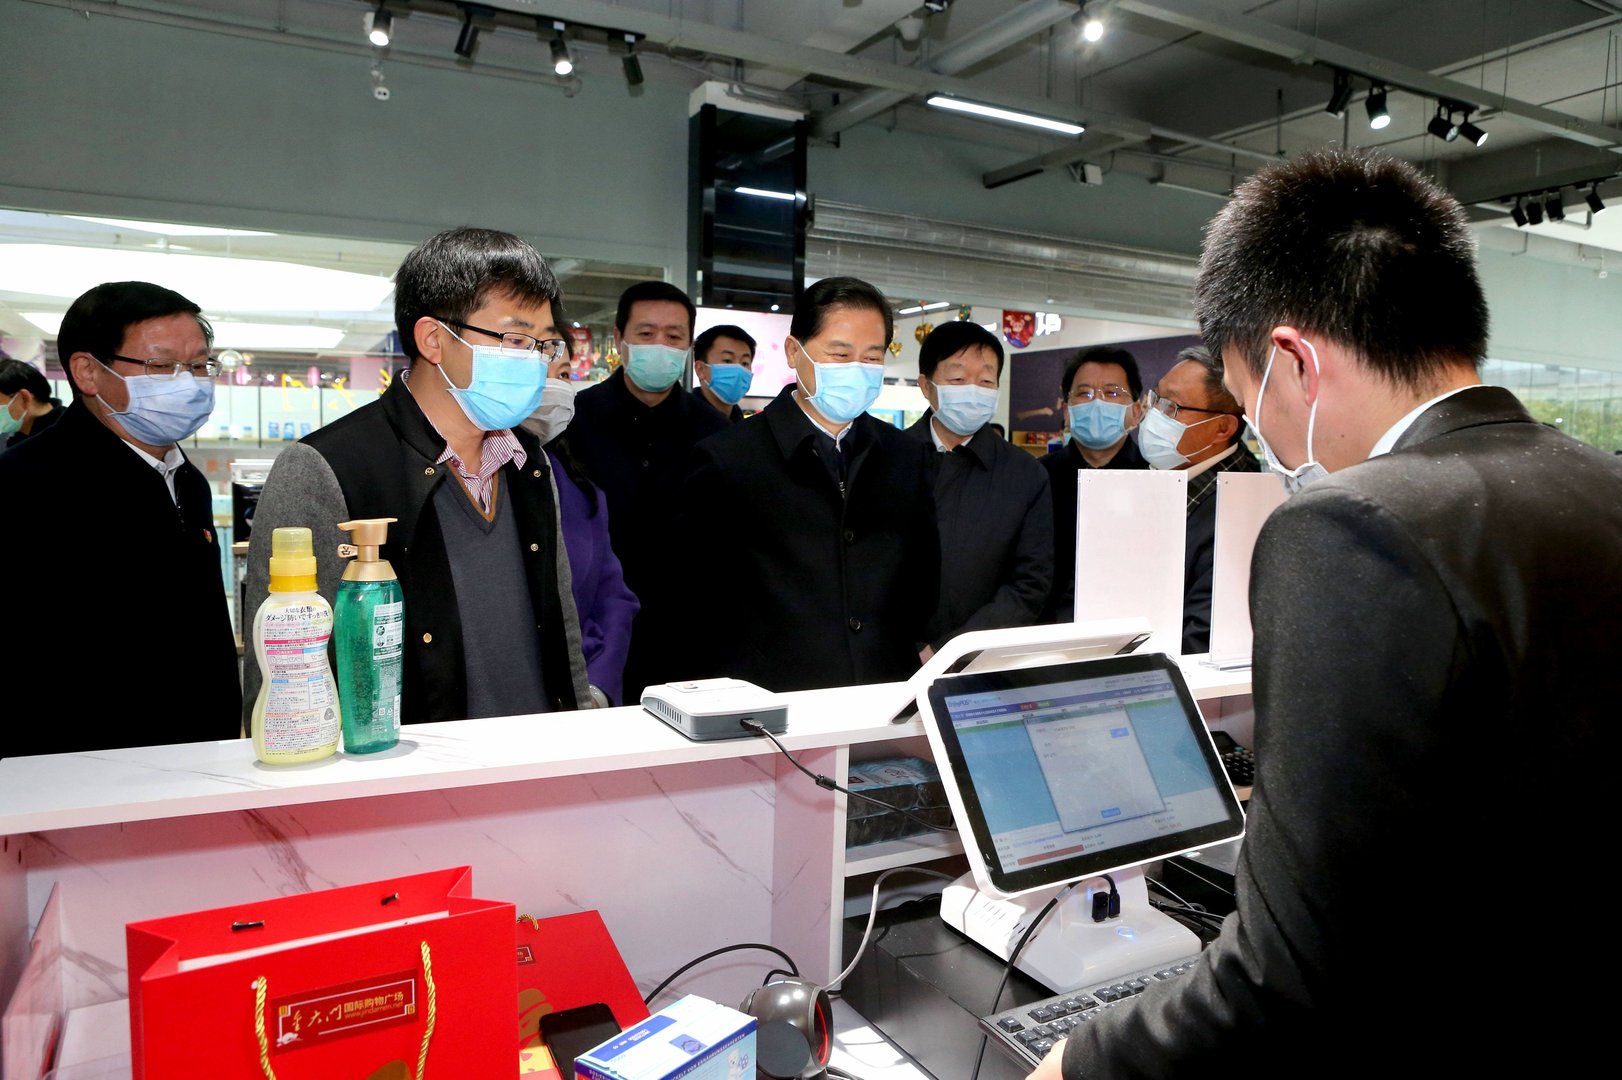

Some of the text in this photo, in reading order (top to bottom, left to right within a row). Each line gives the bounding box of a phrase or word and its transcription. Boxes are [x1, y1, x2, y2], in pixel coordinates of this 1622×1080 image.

[343, 991, 404, 1013] 国际购物广场
[344, 1001, 404, 1019] www.jindamen.net
